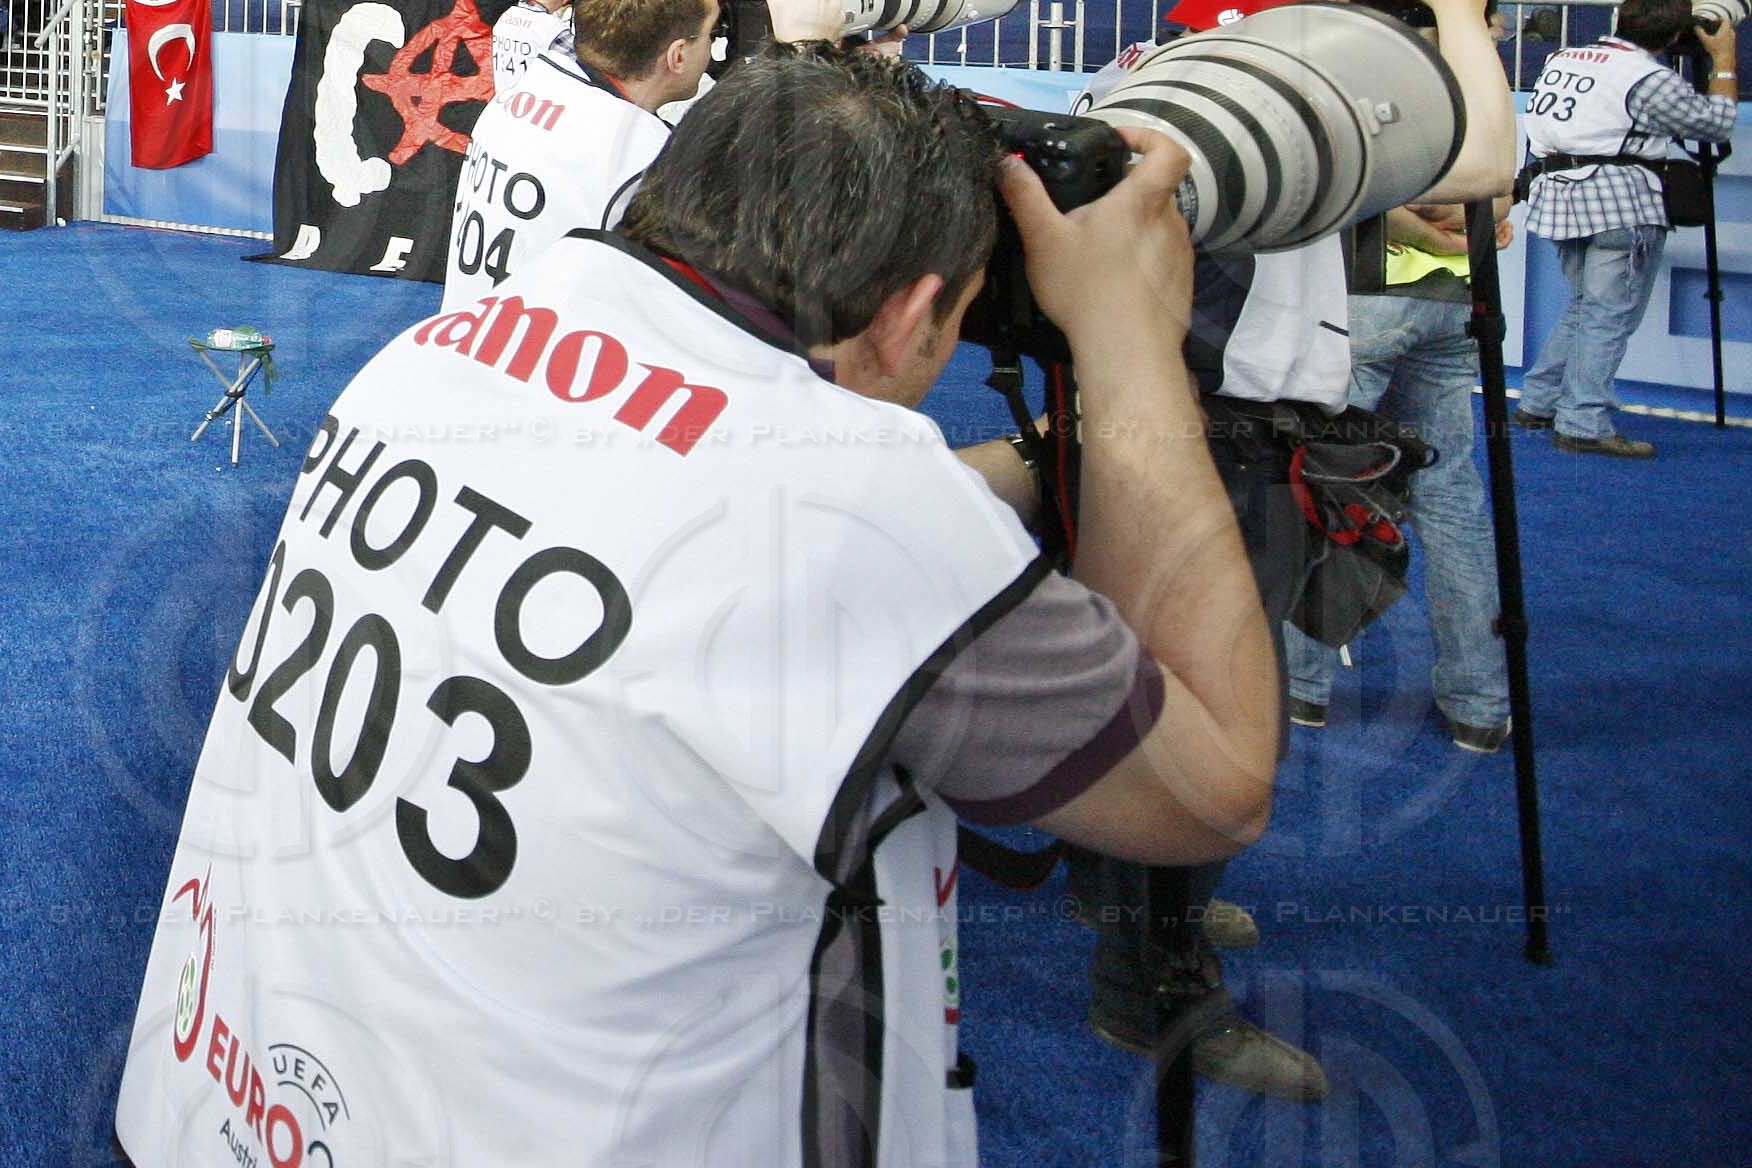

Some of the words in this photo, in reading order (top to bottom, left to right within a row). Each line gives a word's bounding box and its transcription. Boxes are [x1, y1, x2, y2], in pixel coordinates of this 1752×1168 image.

[1542, 69, 1596, 94] OTO
[300, 414, 634, 686] PHOTO
[272, 1054, 340, 1126] UEFA
